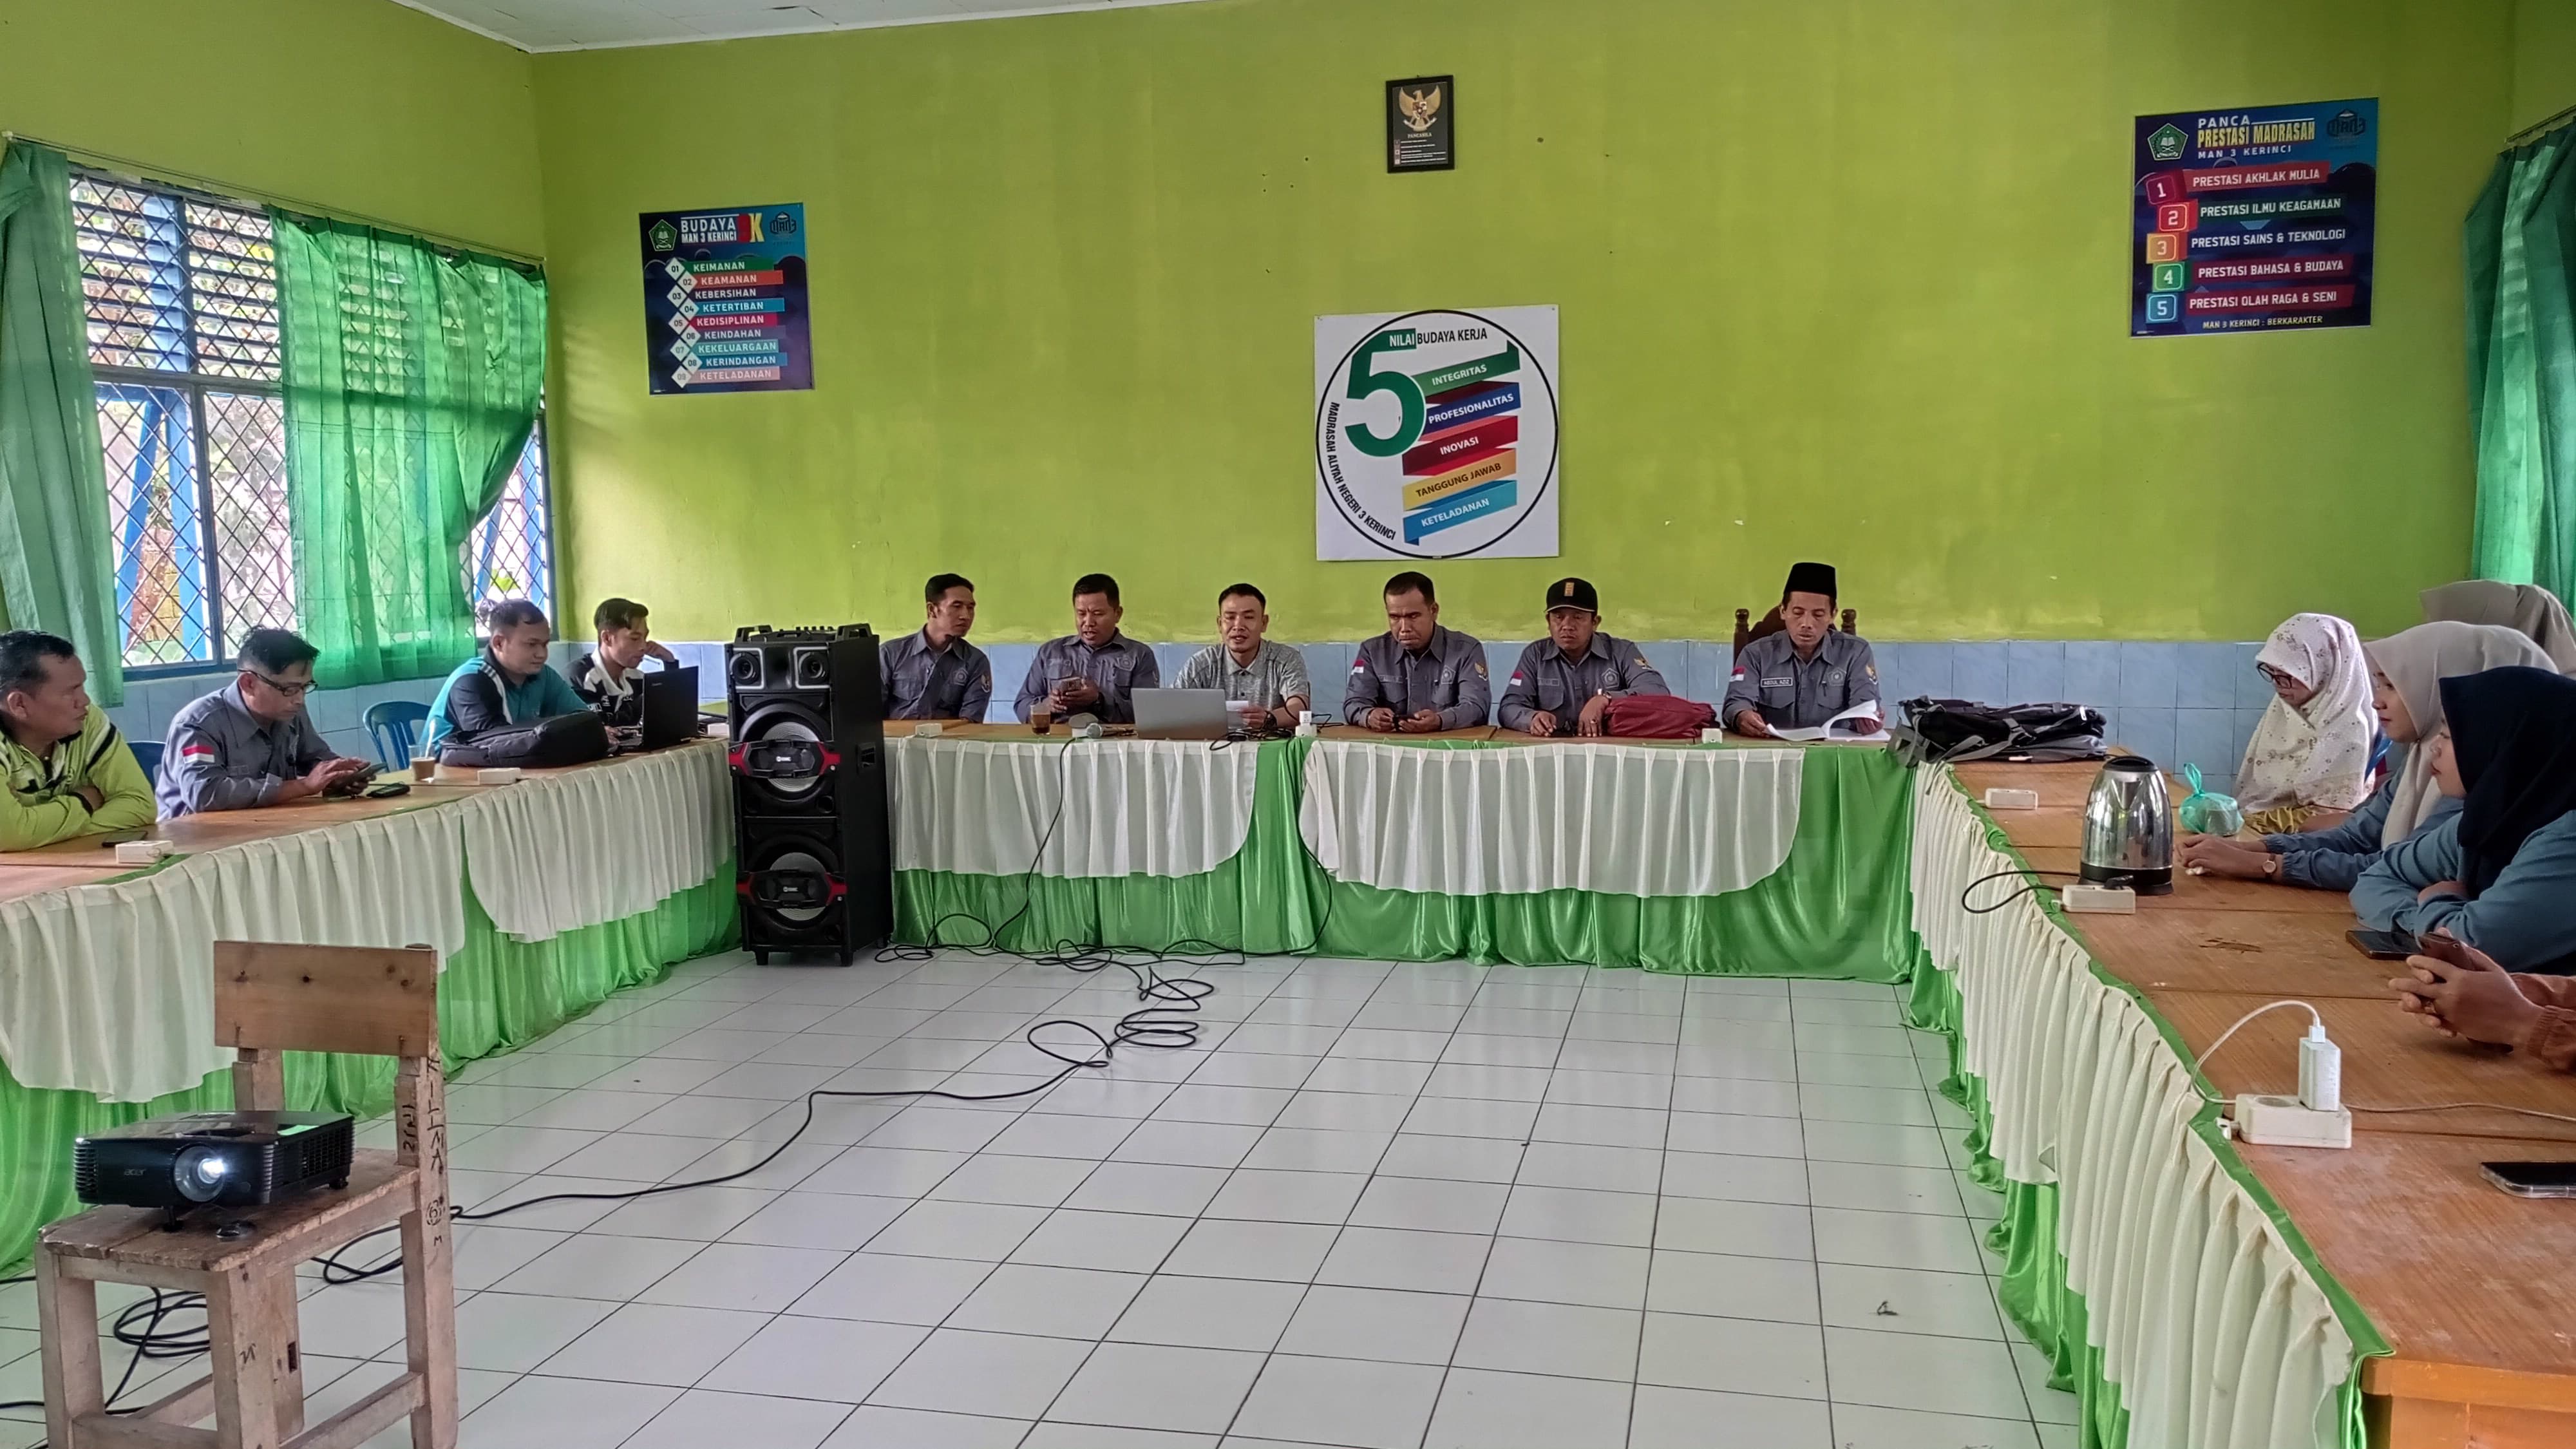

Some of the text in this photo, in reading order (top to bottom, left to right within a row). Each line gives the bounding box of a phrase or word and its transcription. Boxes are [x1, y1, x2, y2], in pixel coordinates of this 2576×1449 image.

[2199, 115, 2250, 128] PANCA
[2197, 121, 2315, 148] PRESTASI MADRASAH
[2198, 150, 2223, 159] MAN
[2244, 145, 2291, 156] KERINCI
[2193, 169, 2320, 187] PRESTASI AKHLAK MULIA
[2157, 182, 2166, 197] 1
[2201, 198, 2341, 217] PRESTASI ILMU KEAGAMAAN
[681, 217, 735, 232] BUDAYA
[2168, 211, 2178, 225] 2
[681, 231, 737, 243] MAN 3 KERINCI
[2192, 229, 2345, 248] PRESTASI SAINS & TEKNOLOGI
[2157, 242, 2167, 256] 3
[694, 261, 745, 272] KEIMANAN
[2199, 260, 2344, 278] PRESTASI BAHASA & BUDAYA
[701, 274, 757, 285] KEAMANAN
[2164, 270, 2174, 284] 4
[695, 289, 756, 299] KEBERSIHAN
[2190, 292, 2336, 309] PRESTASI OLAH RAGA & SENI
[703, 301, 763, 312] KETERTIBAN
[2157, 301, 2167, 316] 5
[697, 315, 764, 327] KEDISIPLINAN
[2268, 316, 2323, 326] BERKARAKTER
[705, 329, 761, 339] KEINDAHAN
[1389, 328, 1488, 347] NILAI BUDAYA KERJA
[698, 342, 776, 353] KEKELUARGAAN
[706, 355, 776, 366] KERINDANGAN
[700, 370, 772, 380] KETELADANAN
[1432, 364, 1488, 386] INTEGRITAS
[1345, 328, 1426, 457] 5
[1428, 393, 1513, 424] PROFESIONALITAS
[1439, 436, 1479, 455] INOVASI
[1326, 402, 1396, 540] MADRASAH ALIYAH NEGERI 3 KERINCI
[1416, 462, 1501, 498] TANGGUNG JAWAB
[1421, 498, 1490, 527] KETELADANAN
